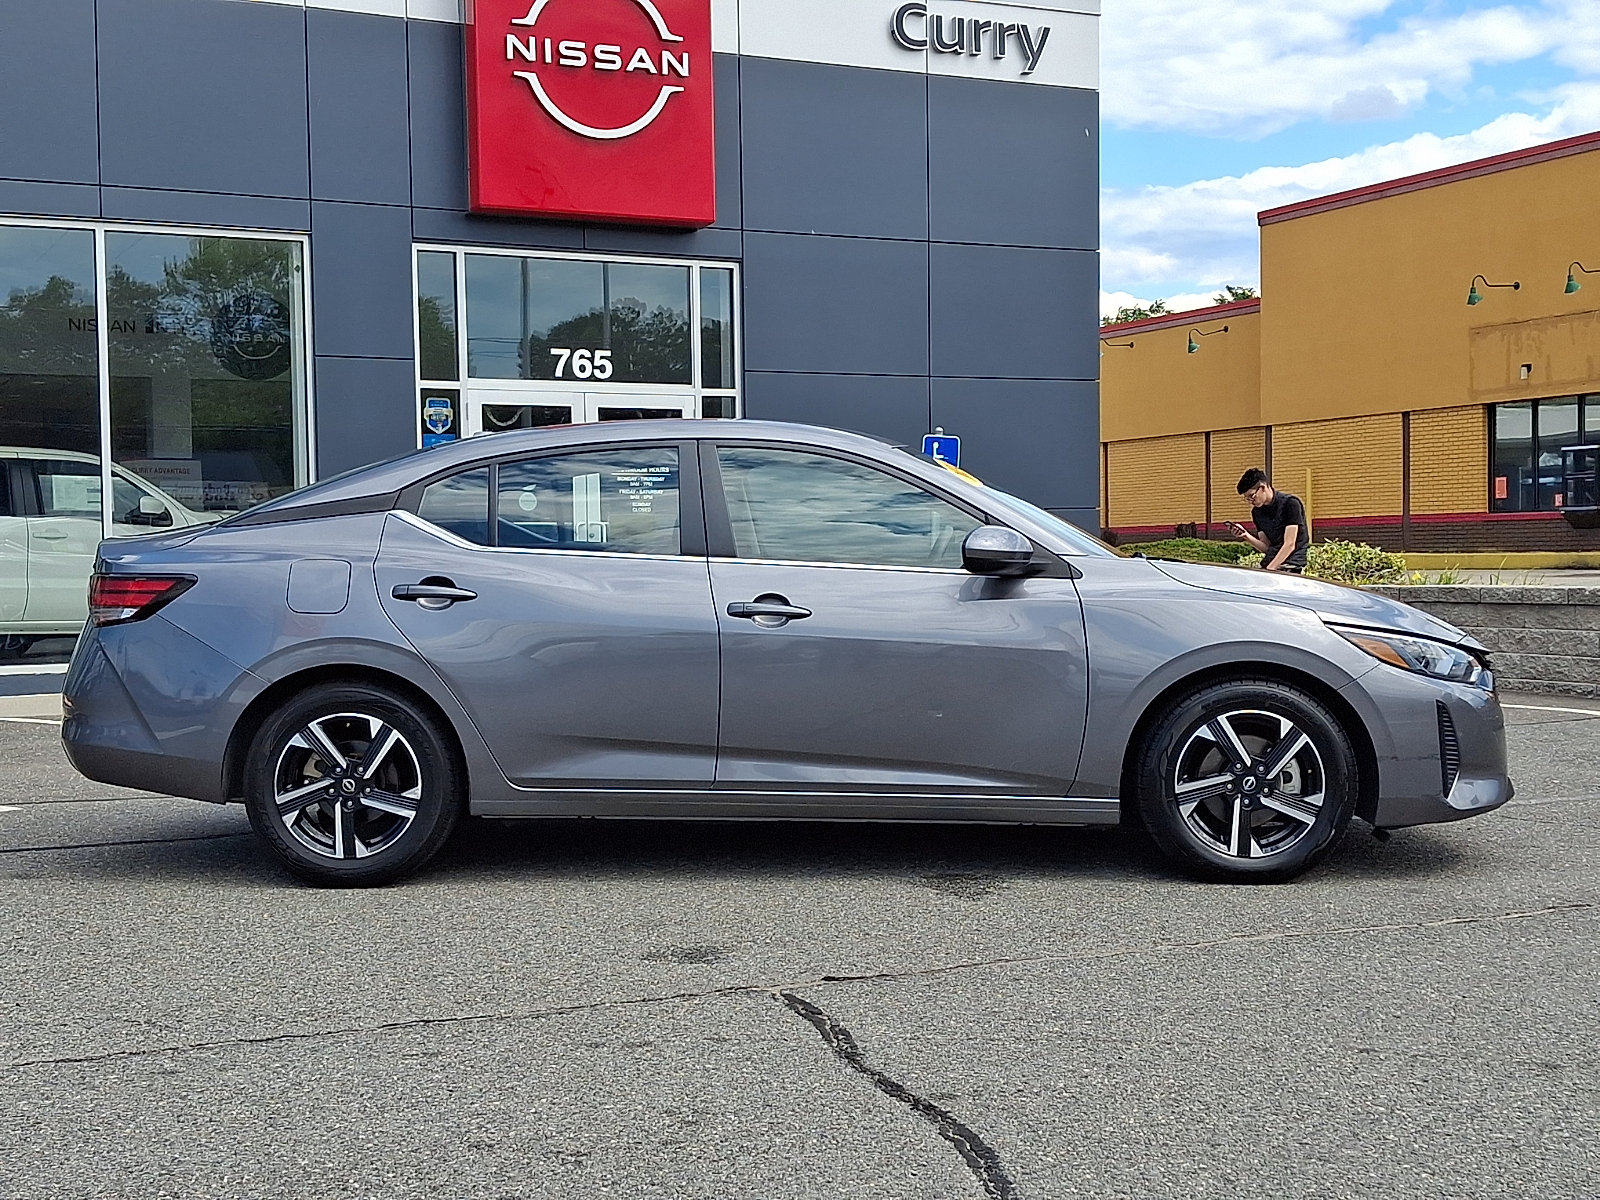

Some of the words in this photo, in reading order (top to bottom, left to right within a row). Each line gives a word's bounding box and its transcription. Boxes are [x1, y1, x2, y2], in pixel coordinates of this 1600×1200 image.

[890, 2, 1051, 74] Curry
[506, 33, 690, 77] NISSAN
[68, 318, 136, 333] NISAN
[550, 347, 613, 380] 765
[154, 467, 191, 475] ADVANTAGE
